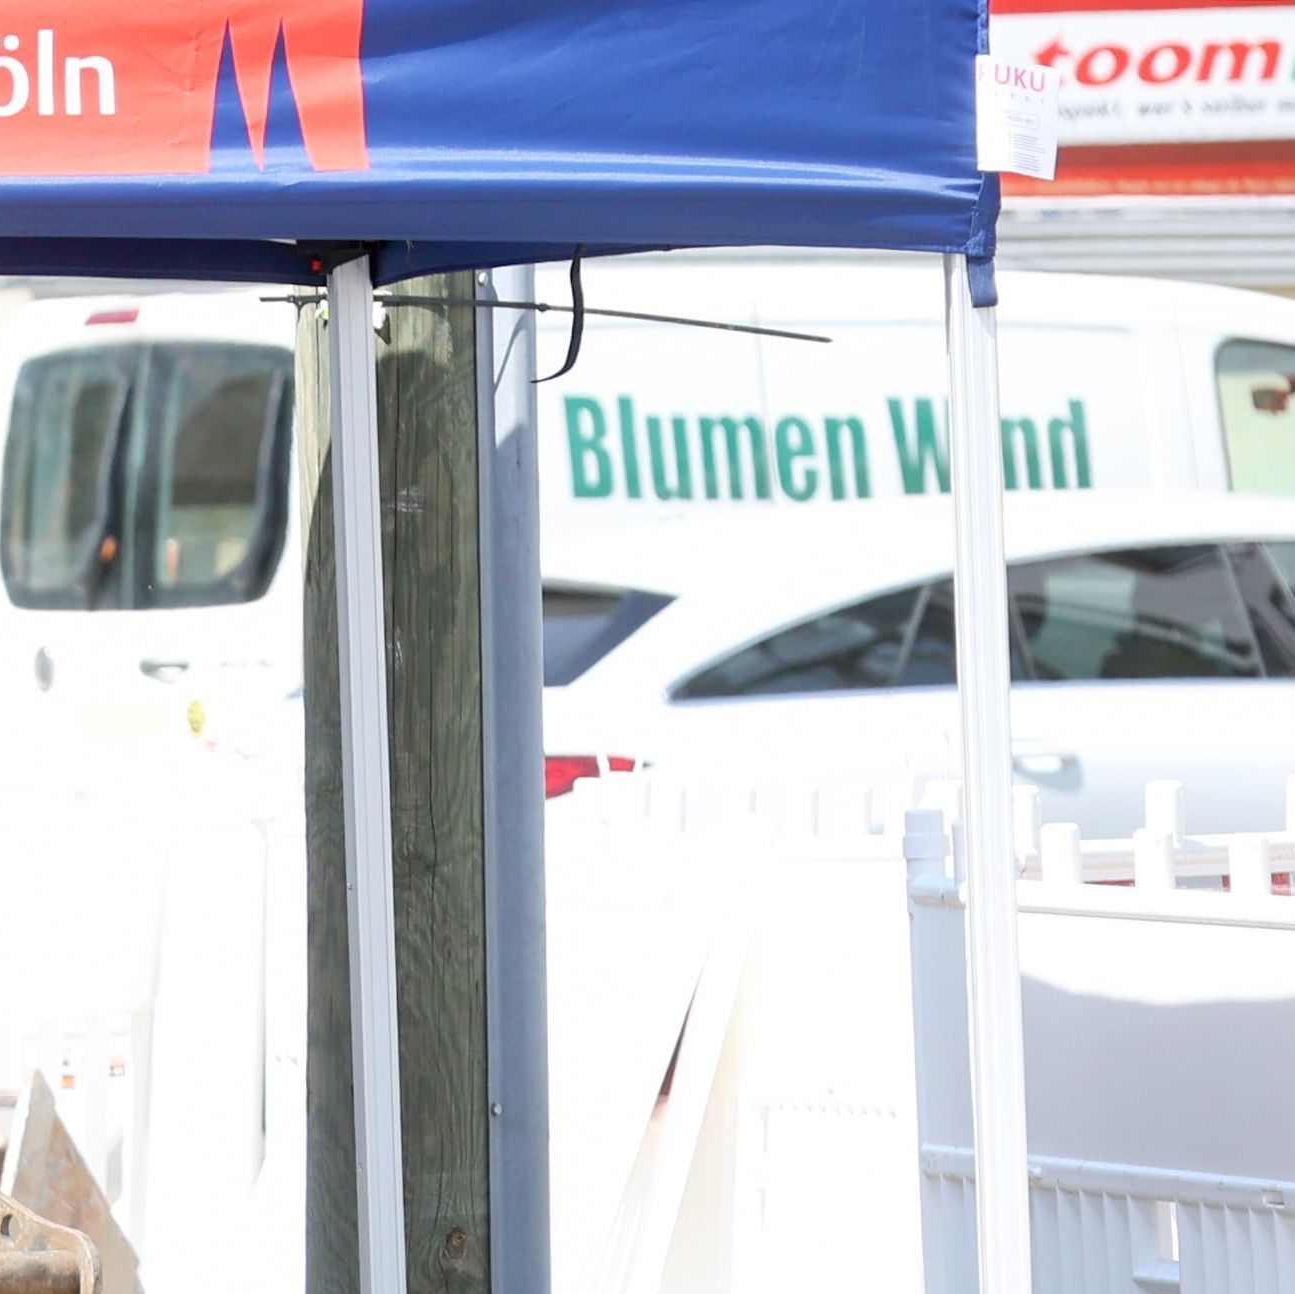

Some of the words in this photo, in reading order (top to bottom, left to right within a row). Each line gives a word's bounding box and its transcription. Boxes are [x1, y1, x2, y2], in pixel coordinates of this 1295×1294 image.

[1033, 32, 1280, 86] toom
[563, 395, 871, 501] Blumen
[886, 397, 1092, 495] Wnd
